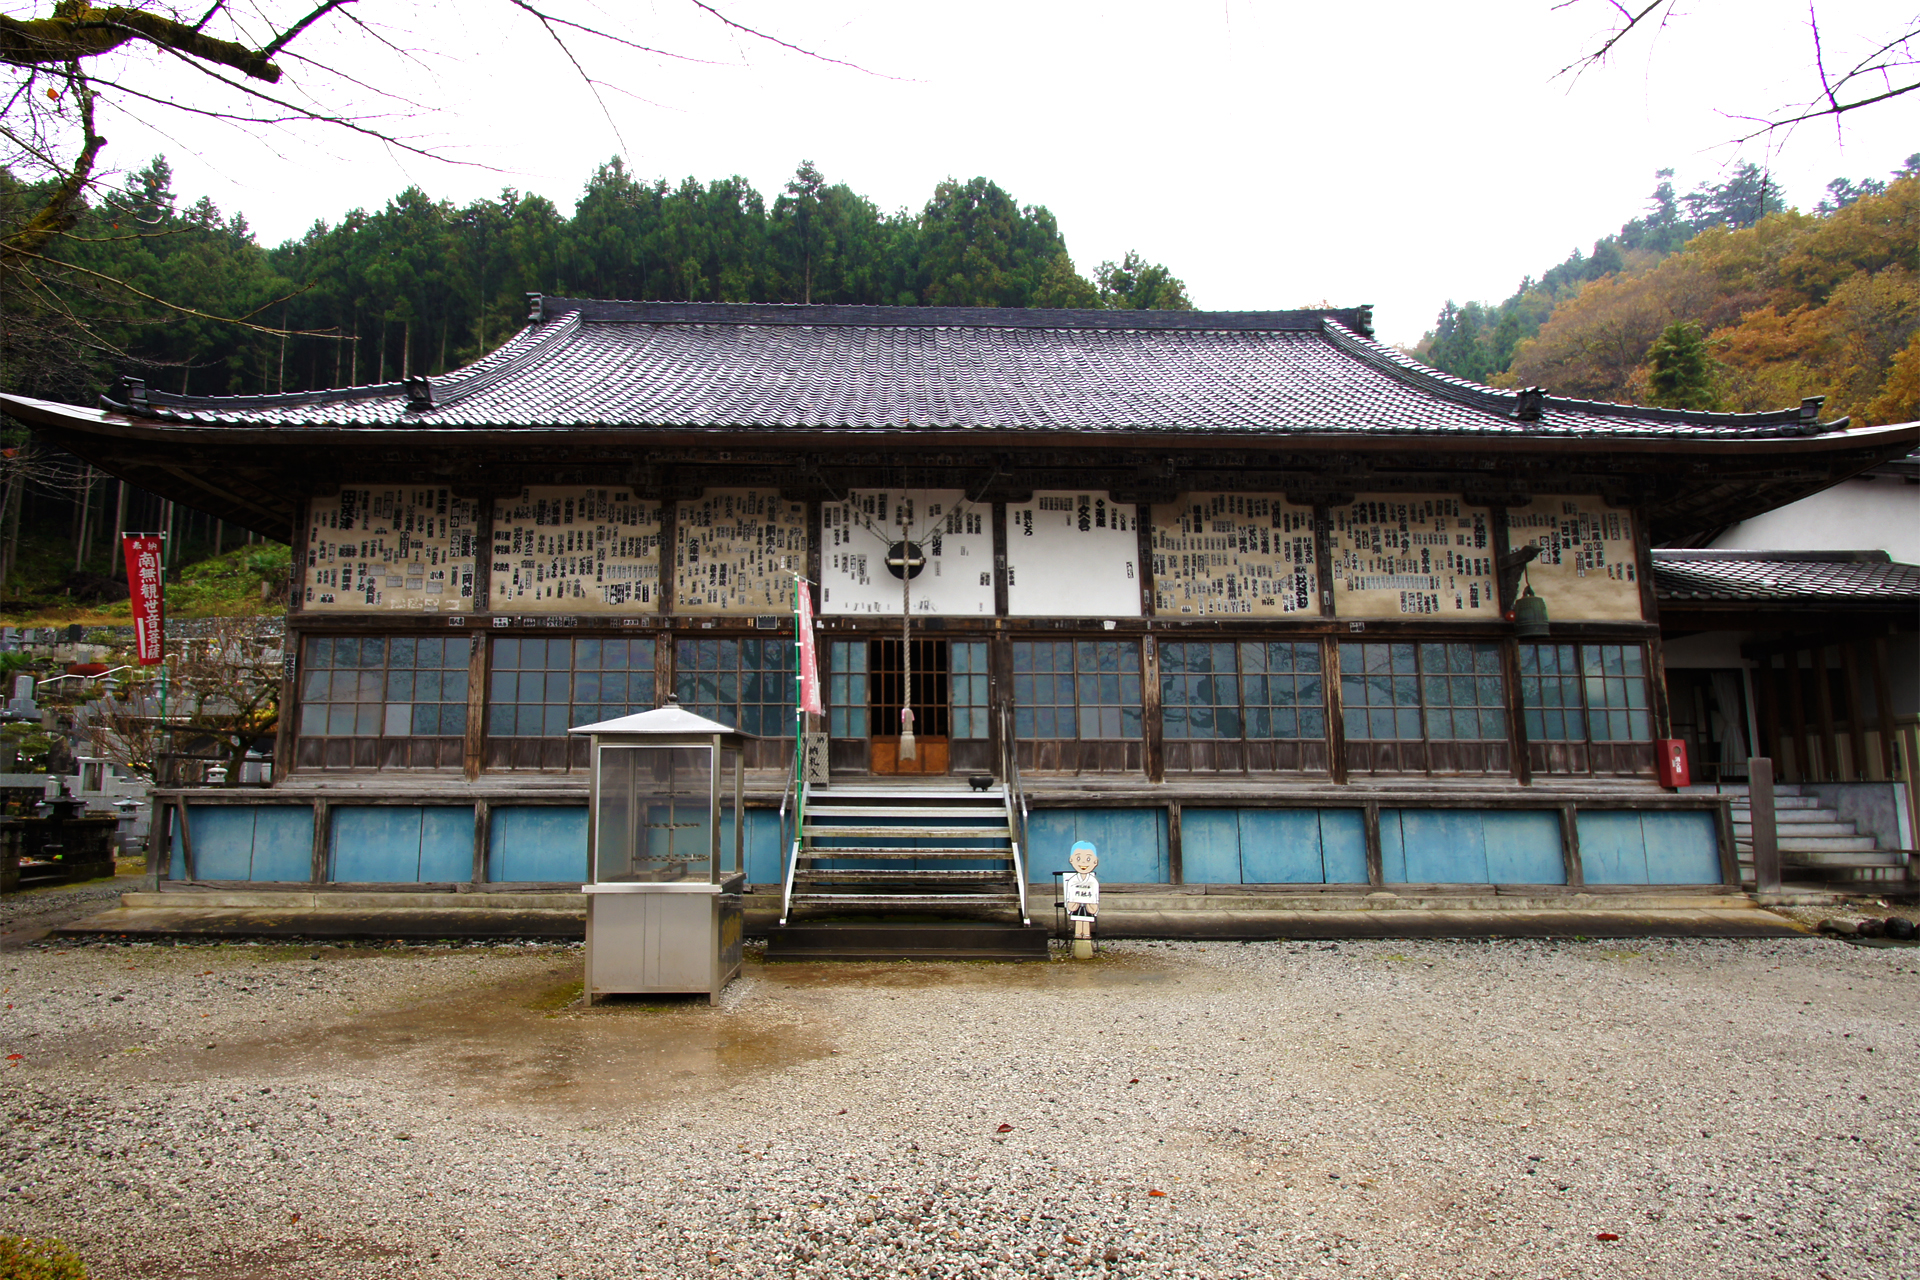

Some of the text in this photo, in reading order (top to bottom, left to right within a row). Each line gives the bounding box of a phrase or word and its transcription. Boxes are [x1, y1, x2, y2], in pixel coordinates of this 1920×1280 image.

[138, 551, 161, 660] 南無観世音菩薩
[809, 746, 820, 777] 納札入
